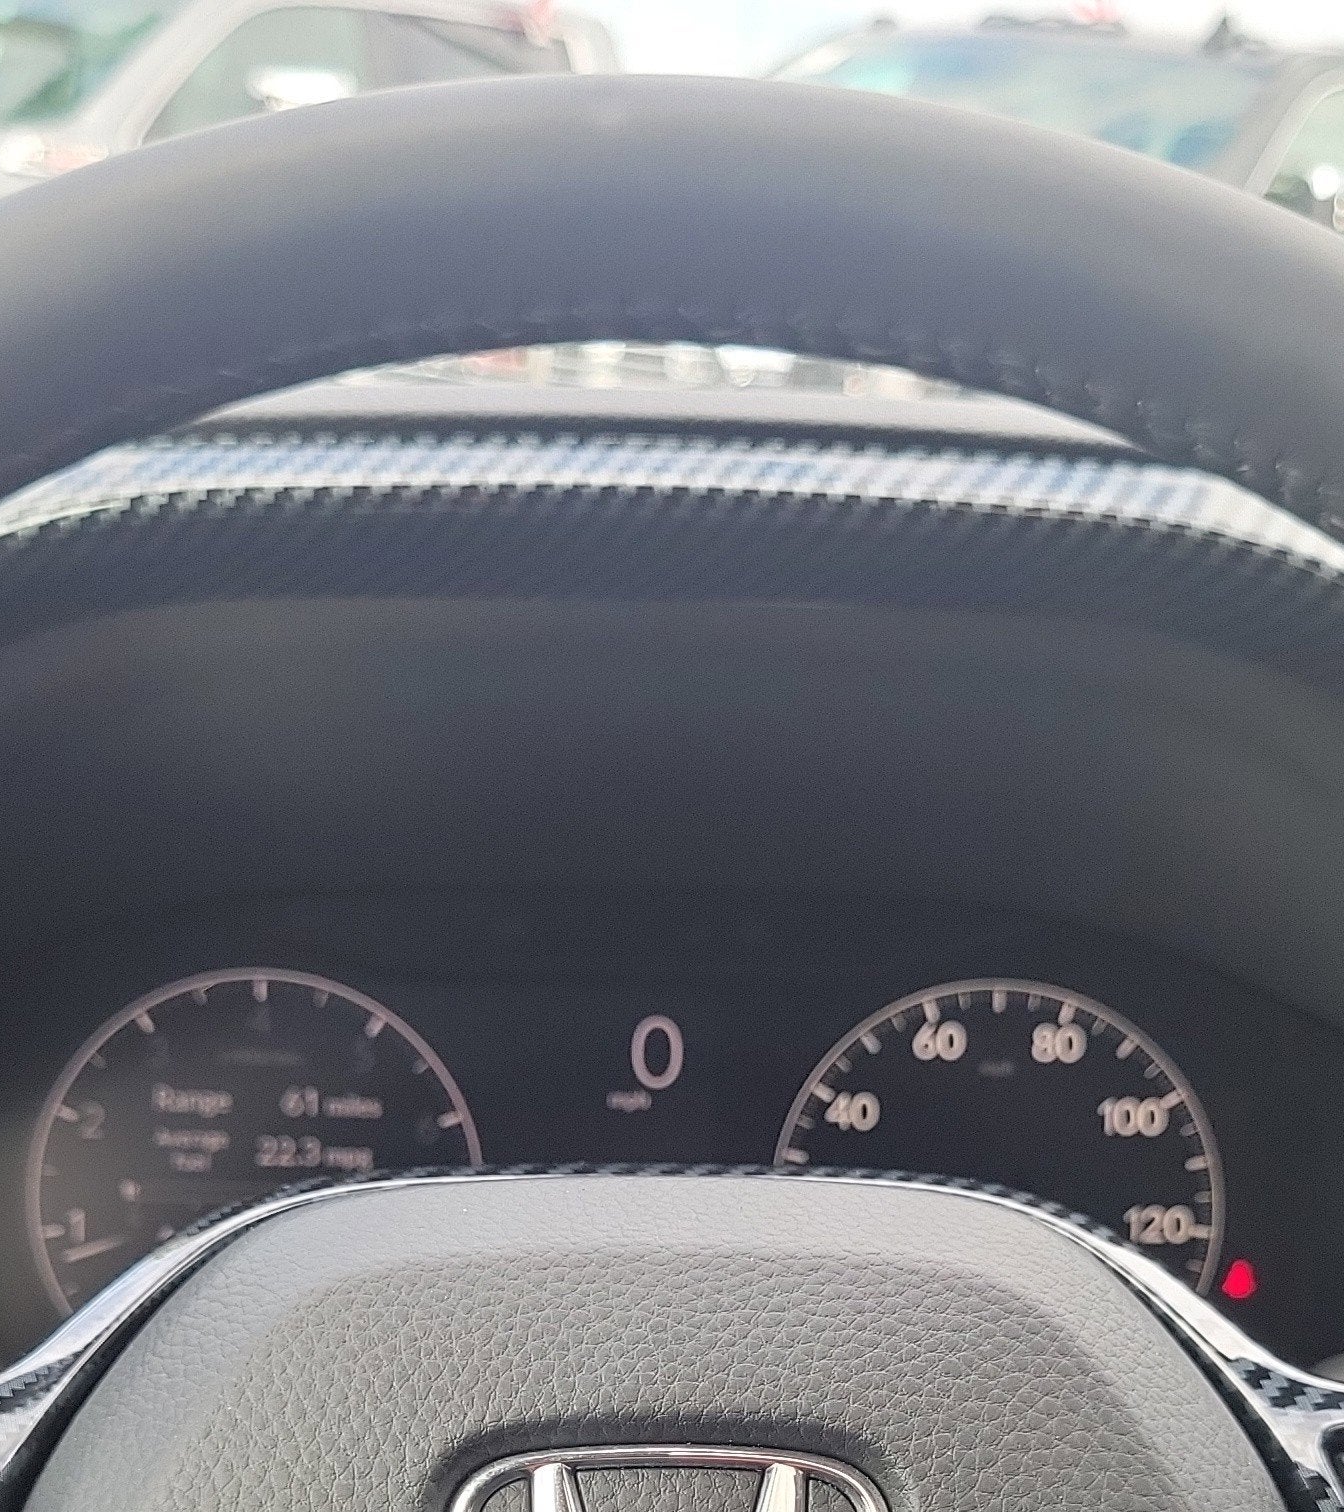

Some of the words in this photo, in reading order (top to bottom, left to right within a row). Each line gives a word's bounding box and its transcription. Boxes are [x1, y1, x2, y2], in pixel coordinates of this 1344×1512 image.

[631, 1013, 683, 1090] 0
[912, 1020, 968, 1062] 60
[1031, 1021, 1088, 1064] 80
[152, 1083, 233, 1117] Range
[824, 1090, 881, 1132] 40
[1098, 1096, 1169, 1137] 100
[1125, 1204, 1195, 1244] 120
